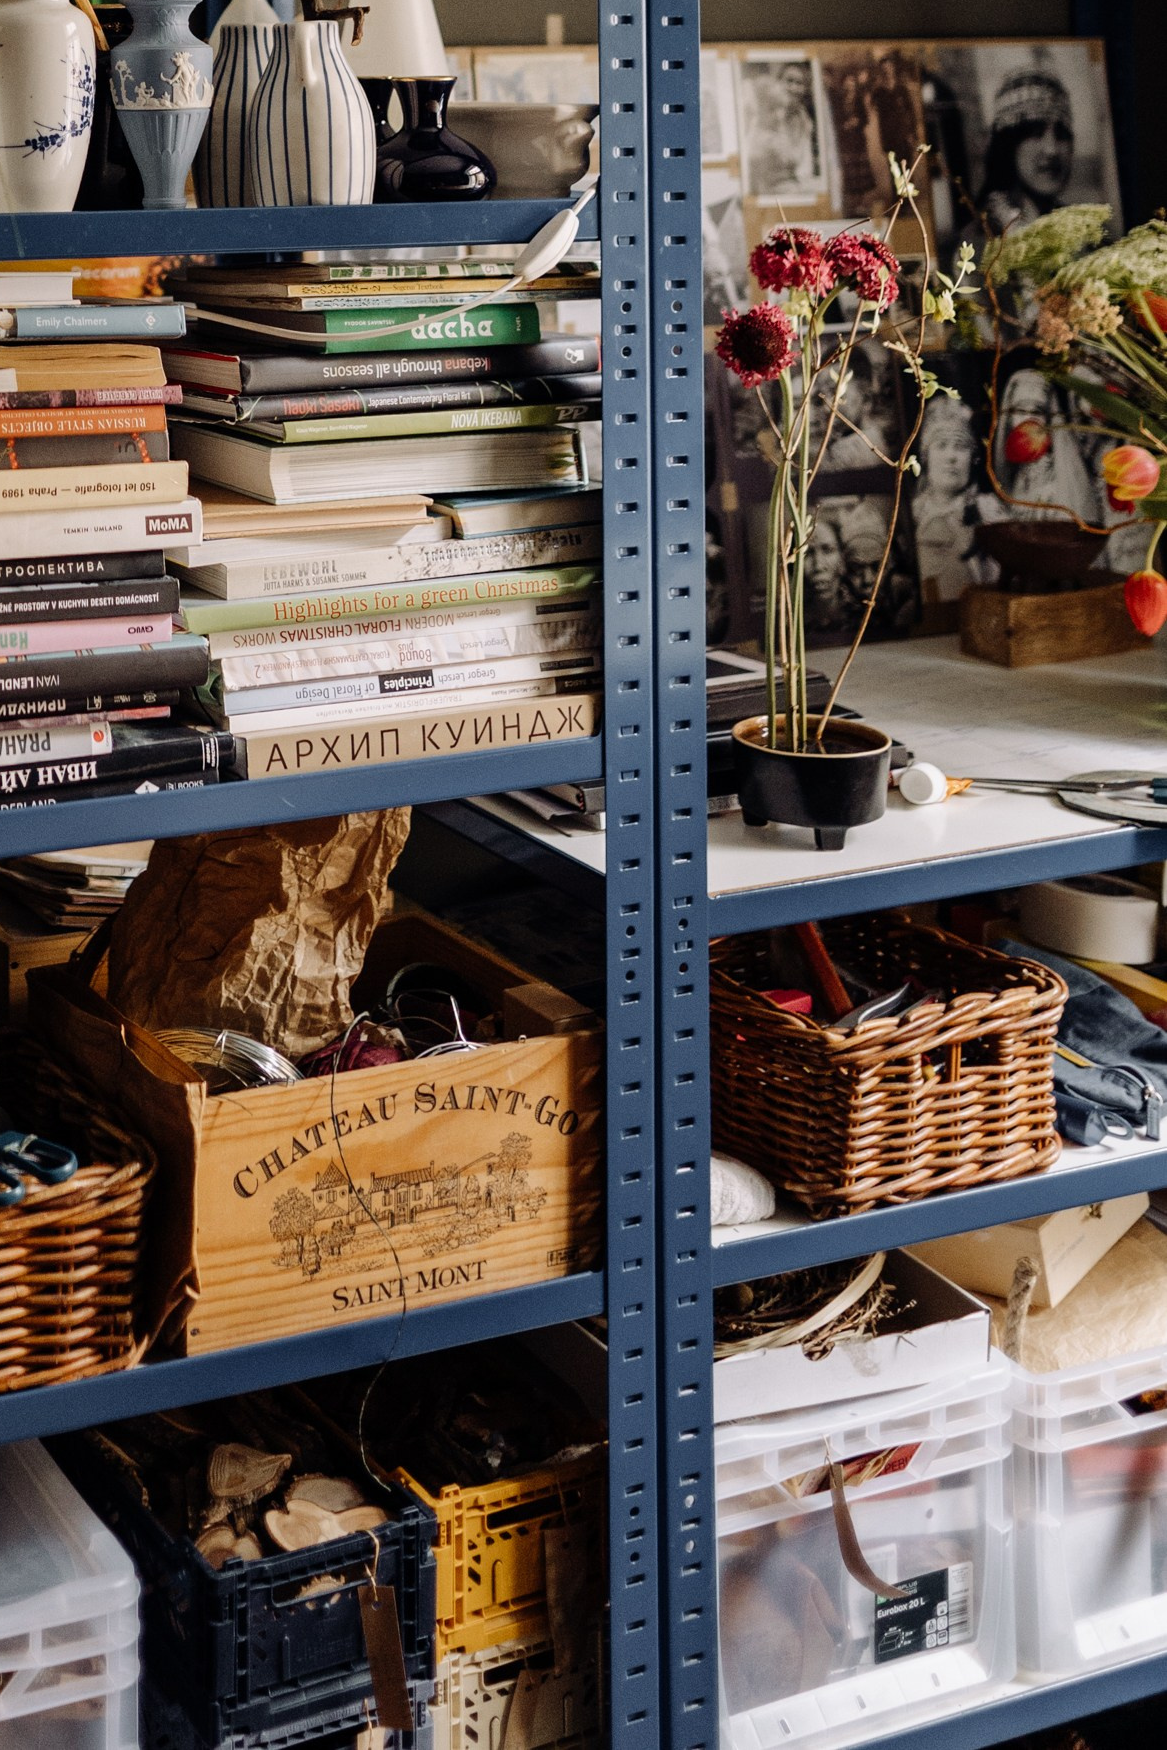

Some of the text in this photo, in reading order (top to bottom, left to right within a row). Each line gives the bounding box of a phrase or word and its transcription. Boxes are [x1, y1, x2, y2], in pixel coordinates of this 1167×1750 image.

[35, 314, 108, 331] Emily Chalmers
[410, 312, 494, 340] dacha
[322, 364, 374, 379] seasons
[375, 363, 391, 379] all
[392, 357, 443, 376] through
[282, 397, 362, 416] Naoki Sasaki
[368, 390, 471, 408] Japanese Contemporary Floral Art
[1, 417, 147, 434] RUSSIAN STYLE OBJECTS
[450, 408, 523, 429] NOVÁ IKEBANA
[1, 481, 156, 497] 150 let fotografie Praha 1989
[62, 524, 124, 535] TEMKIN UMLAND
[148, 514, 189, 532] MoMA
[262, 559, 338, 581] LEBEWOHL
[262, 571, 367, 592] JUTTA HARMS & SUSANNE SOMMER
[14, 600, 50, 613] PROSTORY
[51, 600, 57, 610] V
[58, 598, 89, 610] KUCHYNI
[90, 597, 114, 608] DESETI
[115, 592, 160, 606] DOMÁCNOSTÍ
[273, 575, 559, 623] Highlights for a green Christmas
[456, 607, 501, 620] Gregor Lersch
[232, 613, 455, 649] MODERN FLORAL CHRISTMAS WORKS
[397, 640, 414, 653] plus
[398, 648, 432, 666] Bound
[253, 664, 262, 679] 2
[36, 673, 60, 689] IVAN
[295, 668, 496, 702] Gregor Lersch Principles of Floral Design
[381, 703, 393, 711] mit
[394, 694, 463, 709] TRAUERFLORISTIK
[265, 729, 401, 773] АРХИП
[422, 703, 585, 752] КУИНДЖ
[36, 760, 97, 785] ИВАН
[232, 1082, 580, 1200] CHATEAU SAINT-GO
[331, 1259, 489, 1312] SAINT MONT
[877, 1597, 927, 1619] Eurobox 20 L
